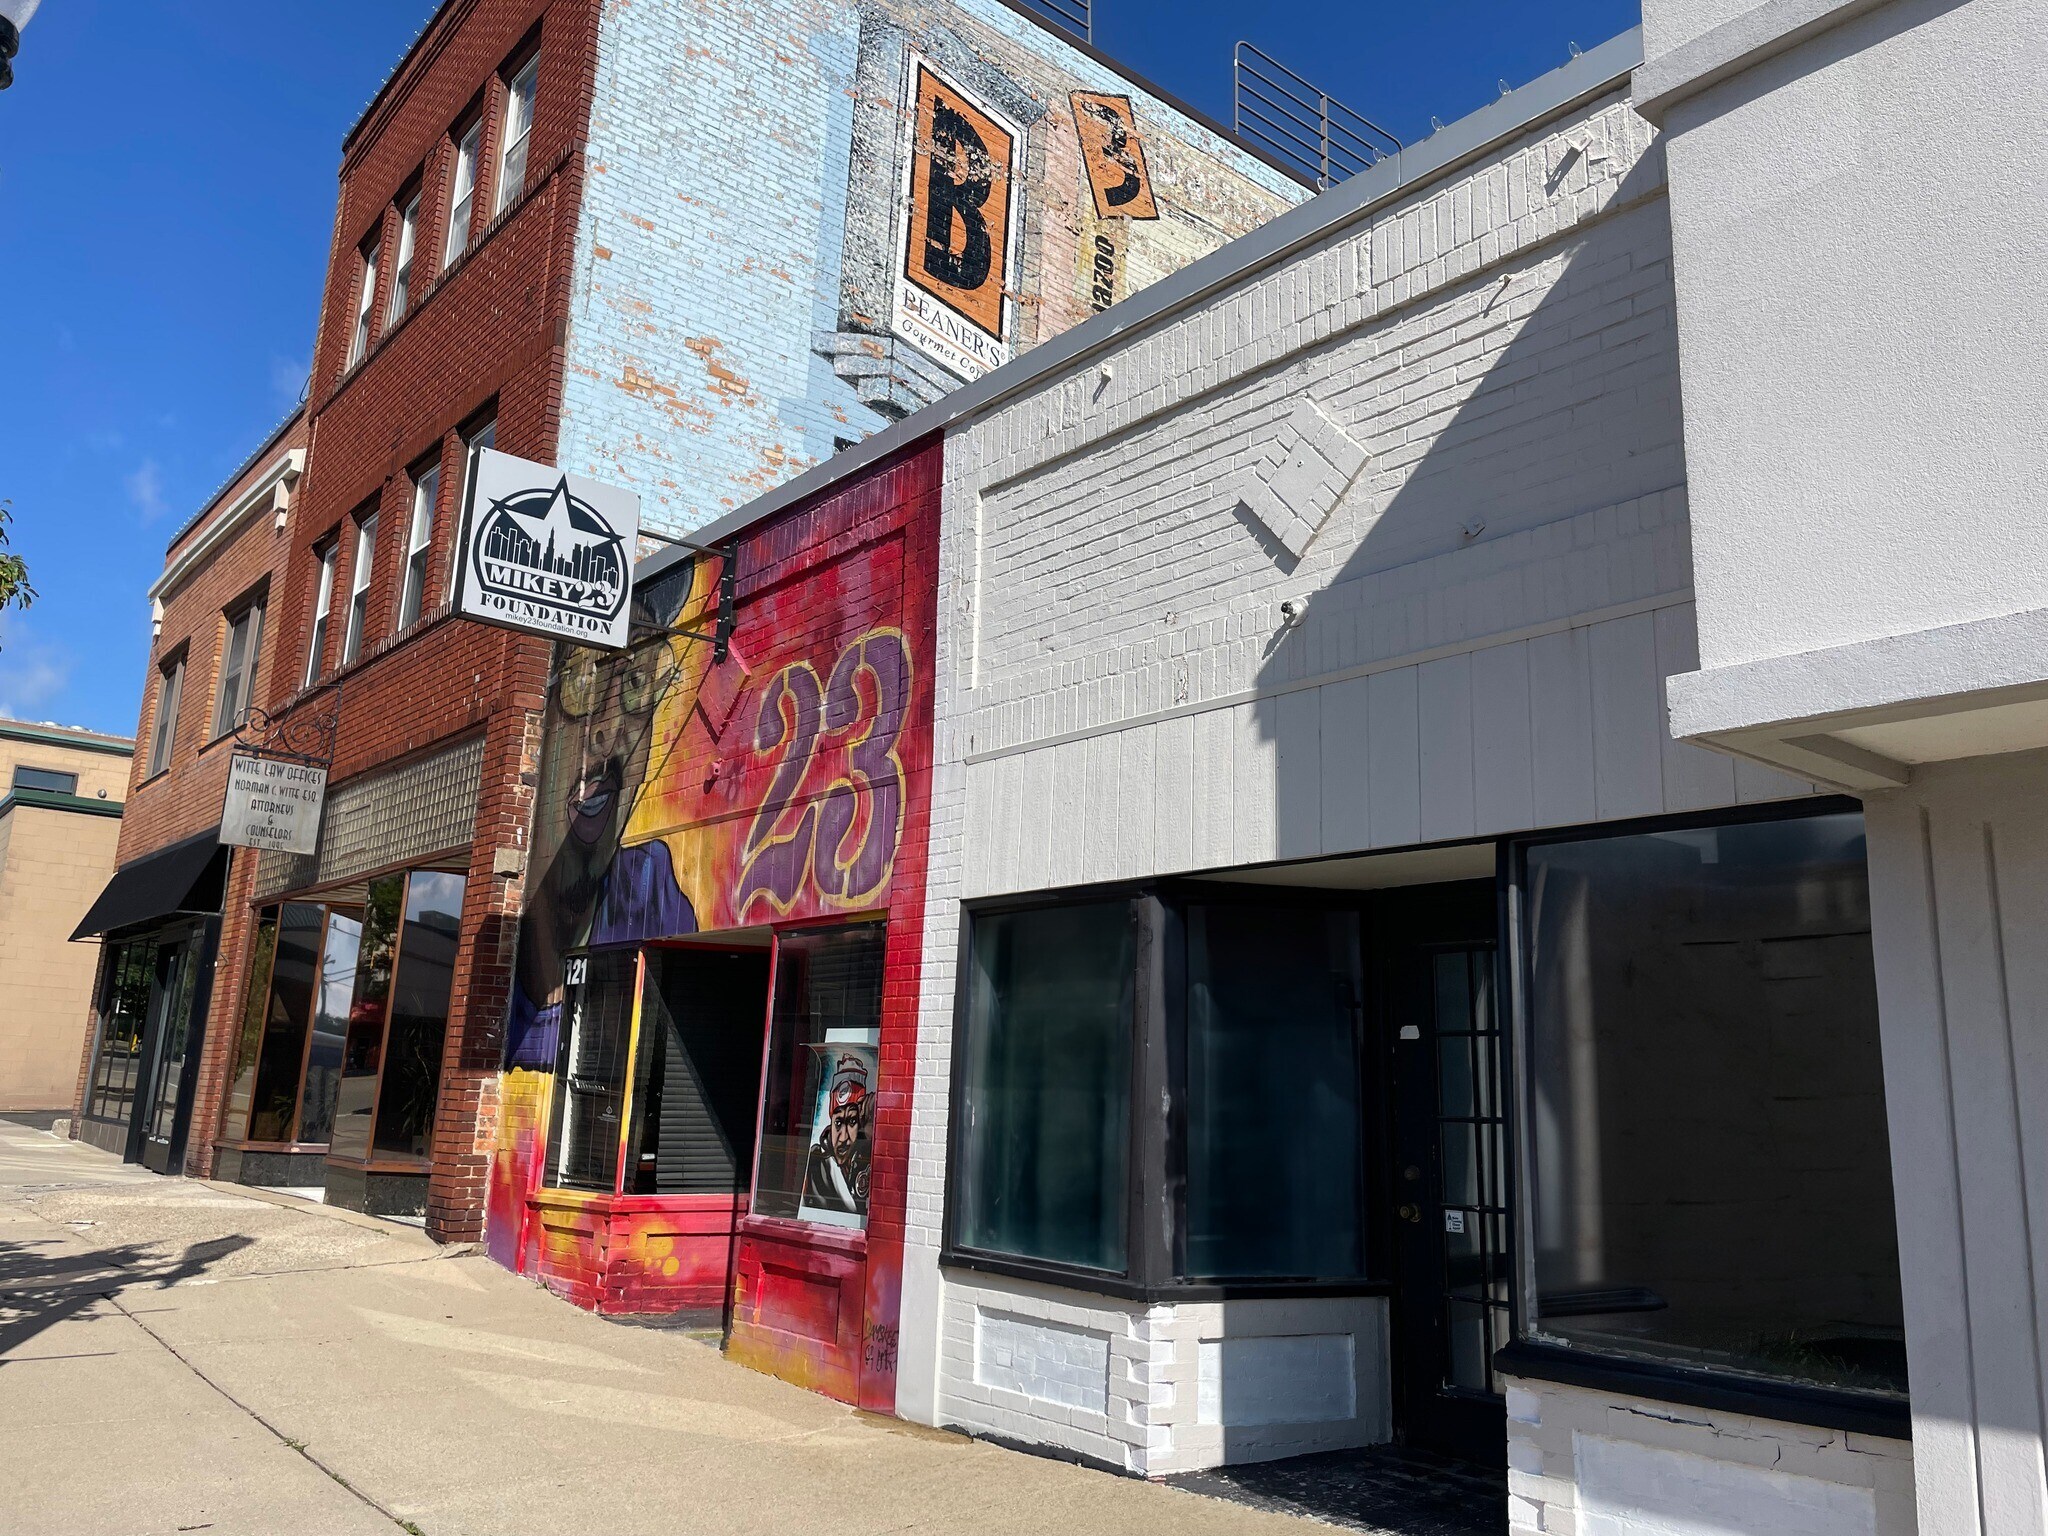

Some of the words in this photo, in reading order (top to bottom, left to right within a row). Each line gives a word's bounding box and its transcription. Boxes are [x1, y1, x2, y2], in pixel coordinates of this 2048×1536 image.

[923, 94, 992, 290] B
[902, 319, 956, 360] Gourmet
[490, 564, 615, 607] MIKEY23
[480, 592, 612, 635] FOUNDATION
[505, 612, 588, 638] mikey23foundation.org
[235, 759, 261, 775] WITTE
[264, 763, 285, 778] LAW
[287, 767, 322, 784] OFFICES
[738, 626, 913, 922] 23
[234, 779, 269, 795] NORMAN
[280, 786, 300, 799] WITTE
[251, 799, 294, 816] ATTORNEYS
[246, 824, 292, 840] COUNSELORS
[566, 958, 588, 985] 121
